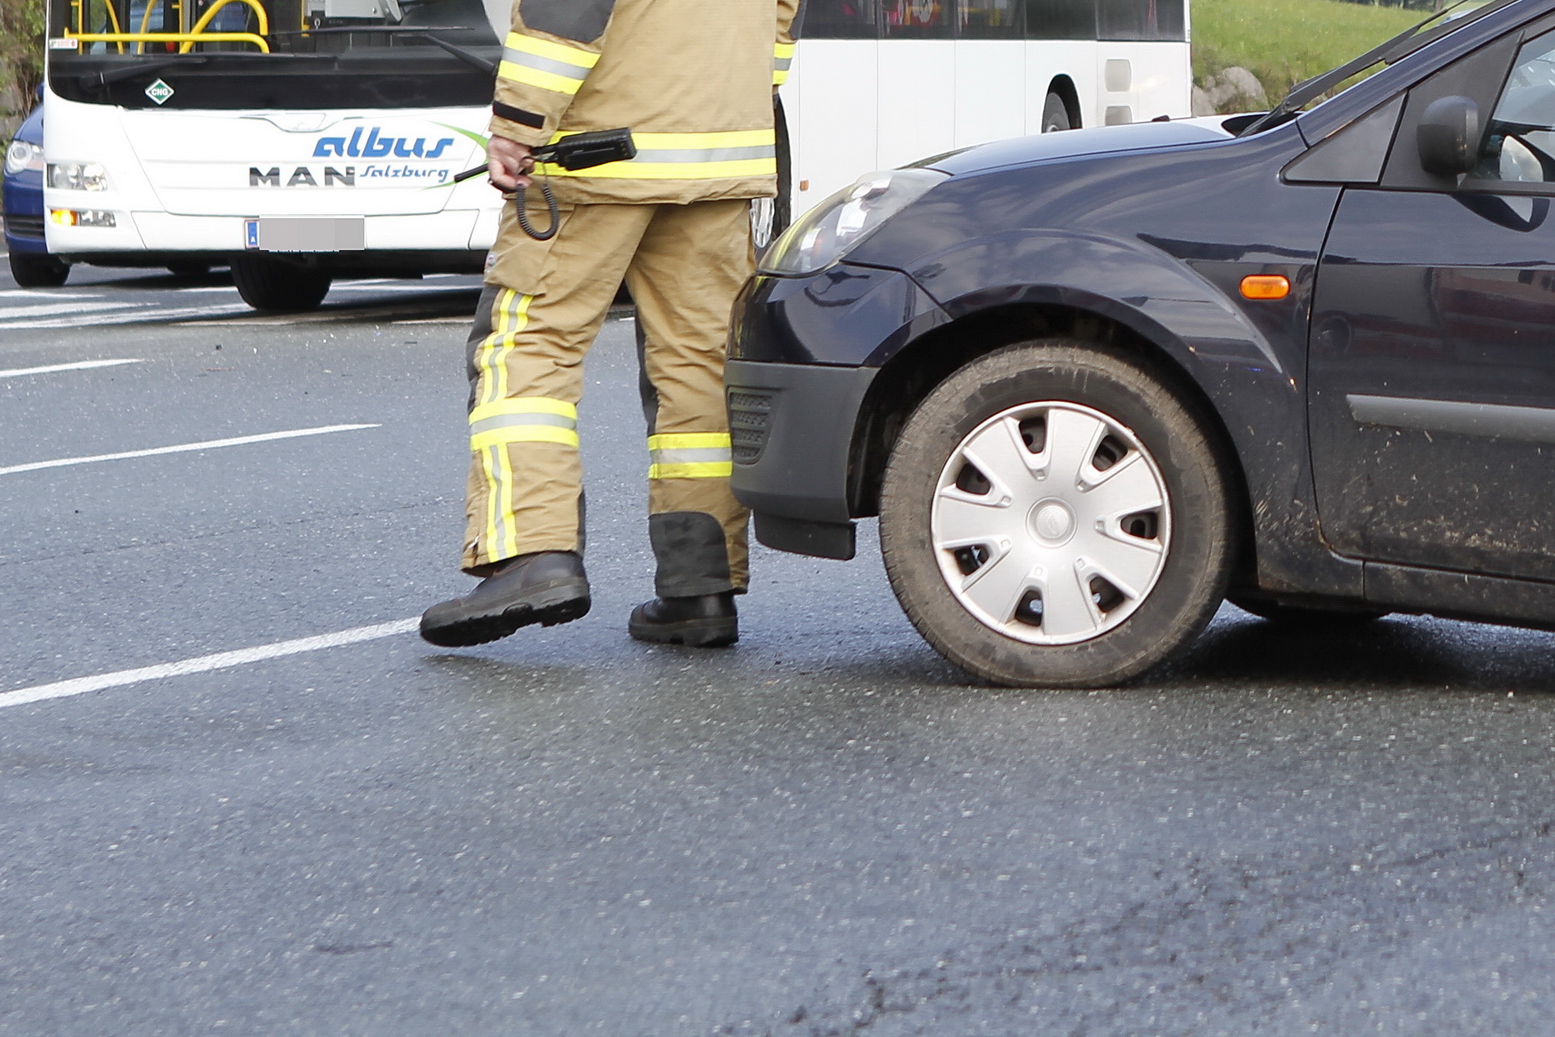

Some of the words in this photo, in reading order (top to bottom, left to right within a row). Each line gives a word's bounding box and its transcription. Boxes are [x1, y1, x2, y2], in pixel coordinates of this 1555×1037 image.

[151, 87, 169, 97] CNG
[312, 126, 455, 159] albus
[249, 166, 356, 187] MAN
[360, 164, 449, 183] Salzburg
